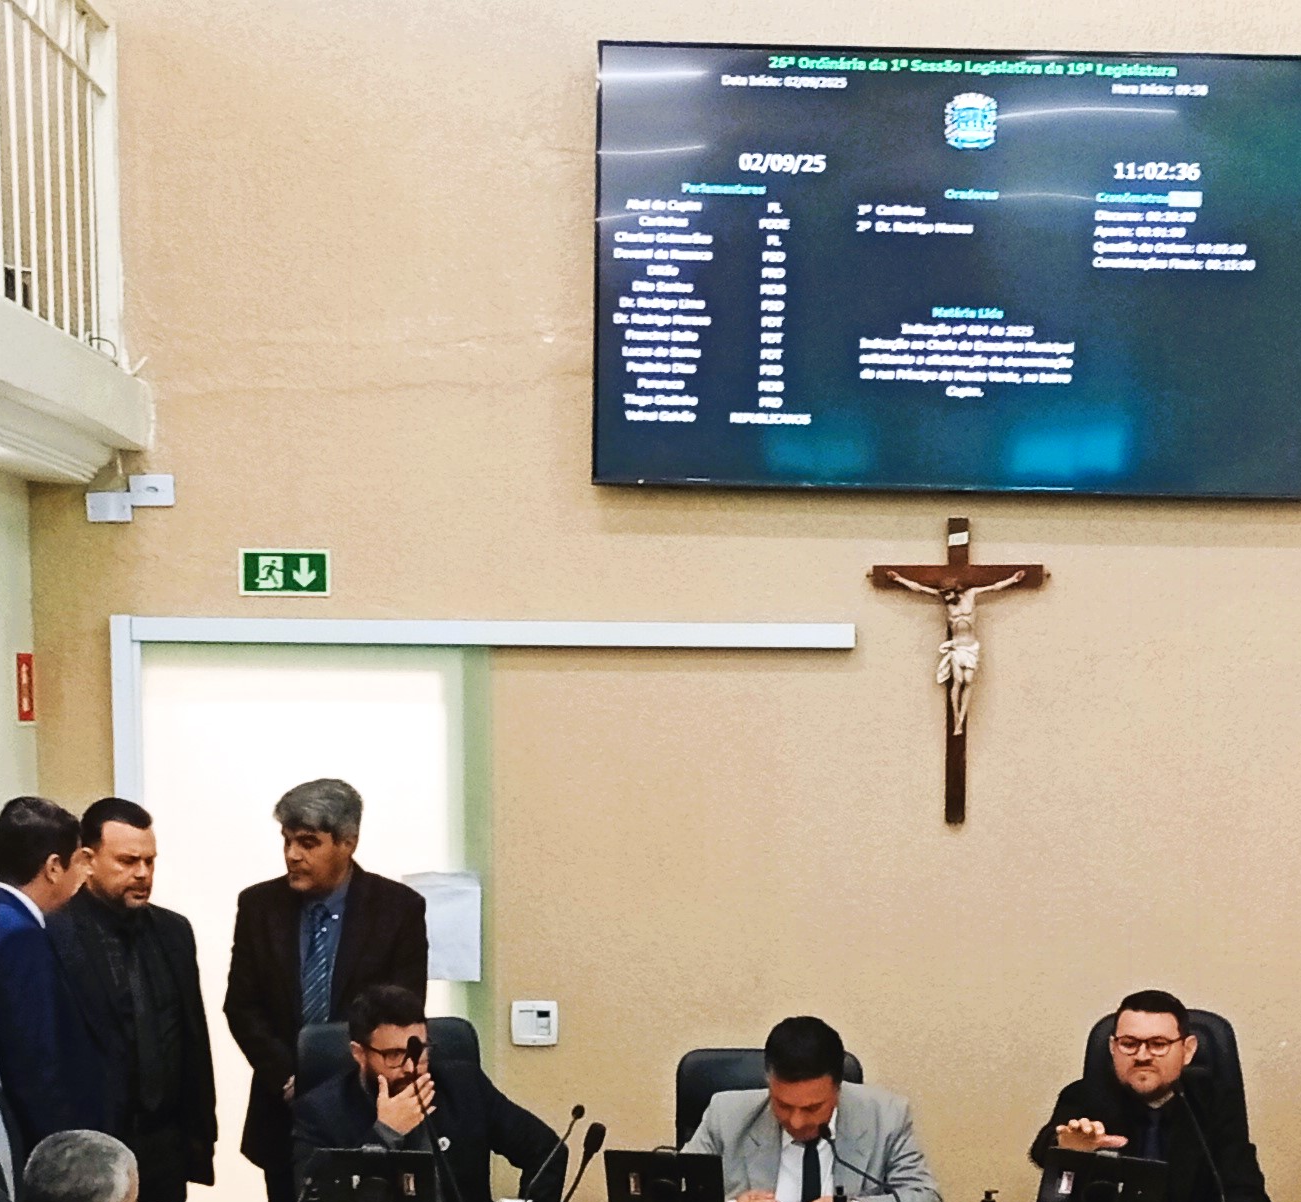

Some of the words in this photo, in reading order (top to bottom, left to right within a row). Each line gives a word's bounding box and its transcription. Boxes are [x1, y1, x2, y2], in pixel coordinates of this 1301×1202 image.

[798, 57, 866, 71] Ordinária
[869, 58, 888, 71] da
[891, 59, 908, 71] 1ª
[910, 59, 963, 73] Sessão
[965, 60, 1042, 76] Legislativa
[1044, 61, 1064, 75] da
[1067, 62, 1094, 76] 19ª
[1096, 63, 1178, 79] Legislatura
[738, 153, 827, 175] 02/09/25
[1113, 161, 1201, 181] 11:02:36
